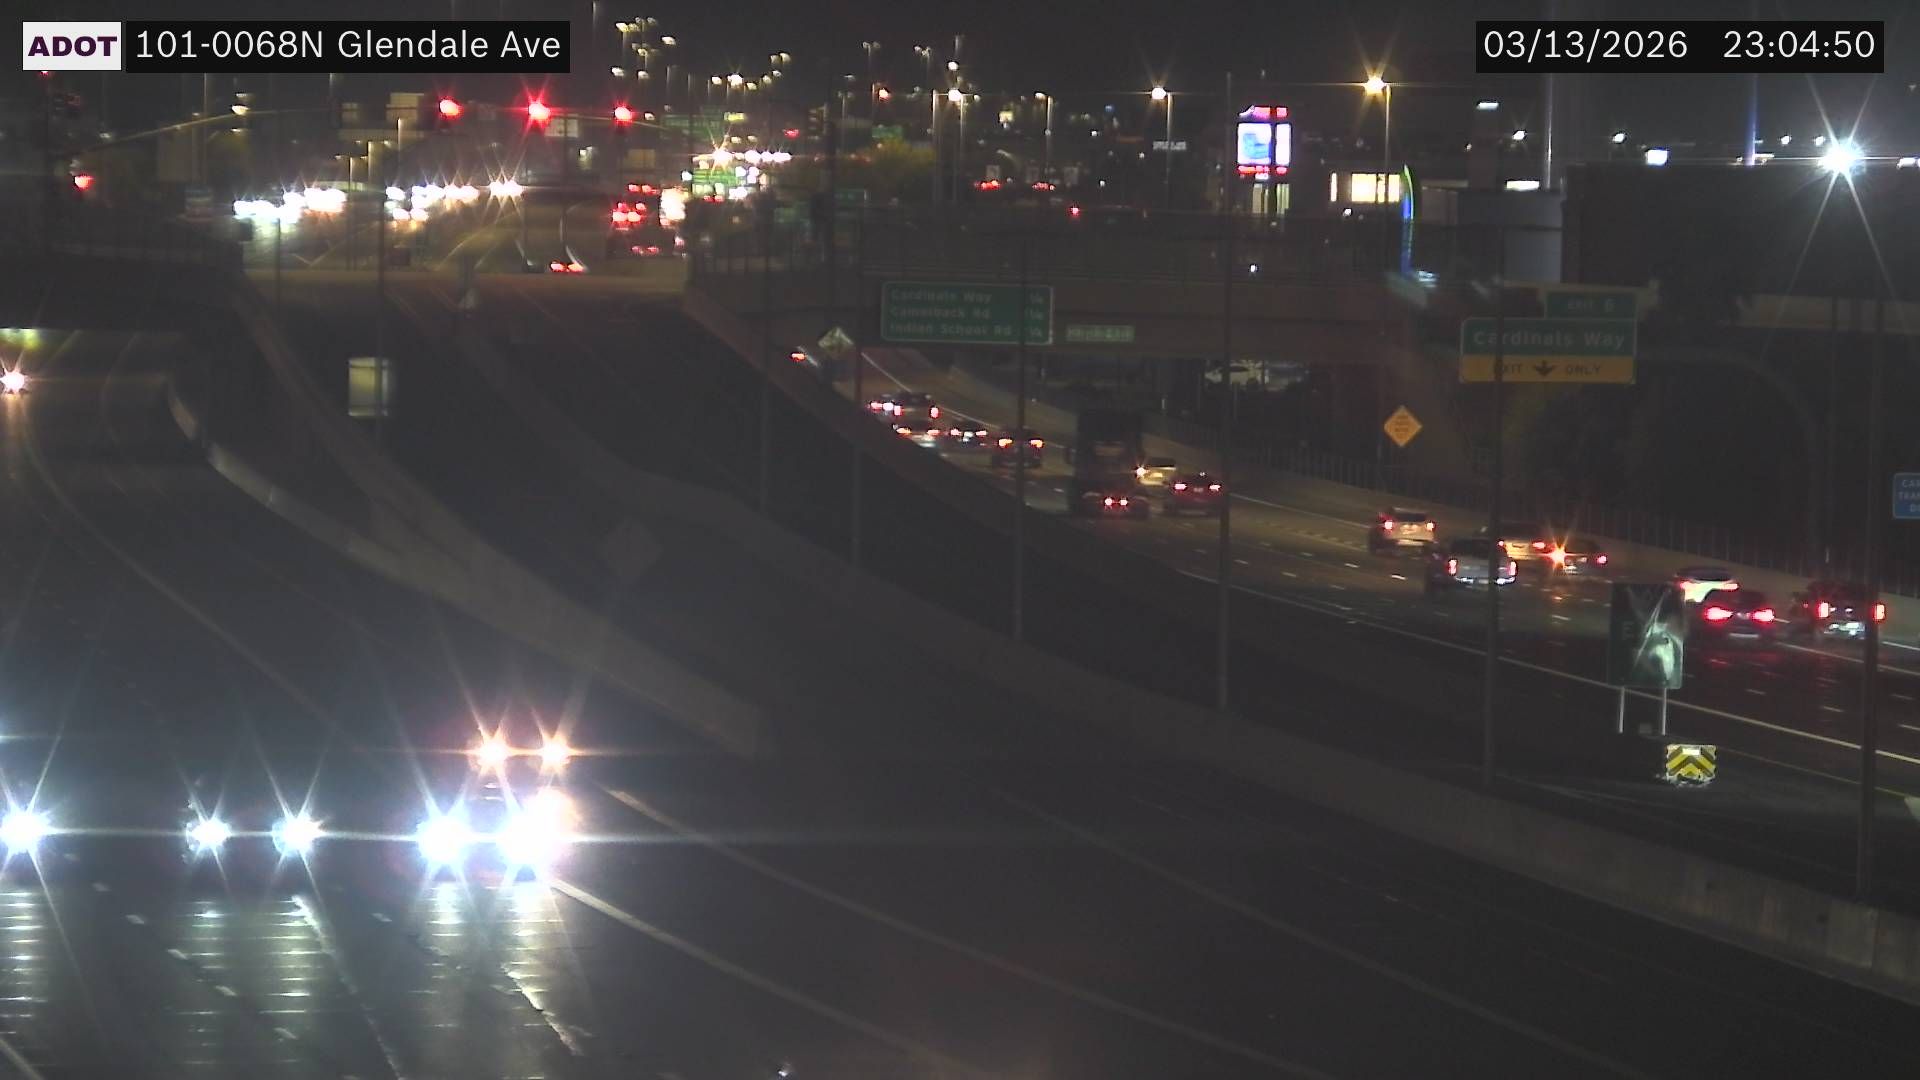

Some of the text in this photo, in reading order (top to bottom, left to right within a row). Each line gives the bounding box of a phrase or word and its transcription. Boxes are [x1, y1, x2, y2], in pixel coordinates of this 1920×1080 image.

[962, 289, 992, 304] Way
[993, 323, 1012, 336] Rd
[1472, 329, 1625, 350] Cardinals Way
[1566, 363, 1601, 376] ONLY
